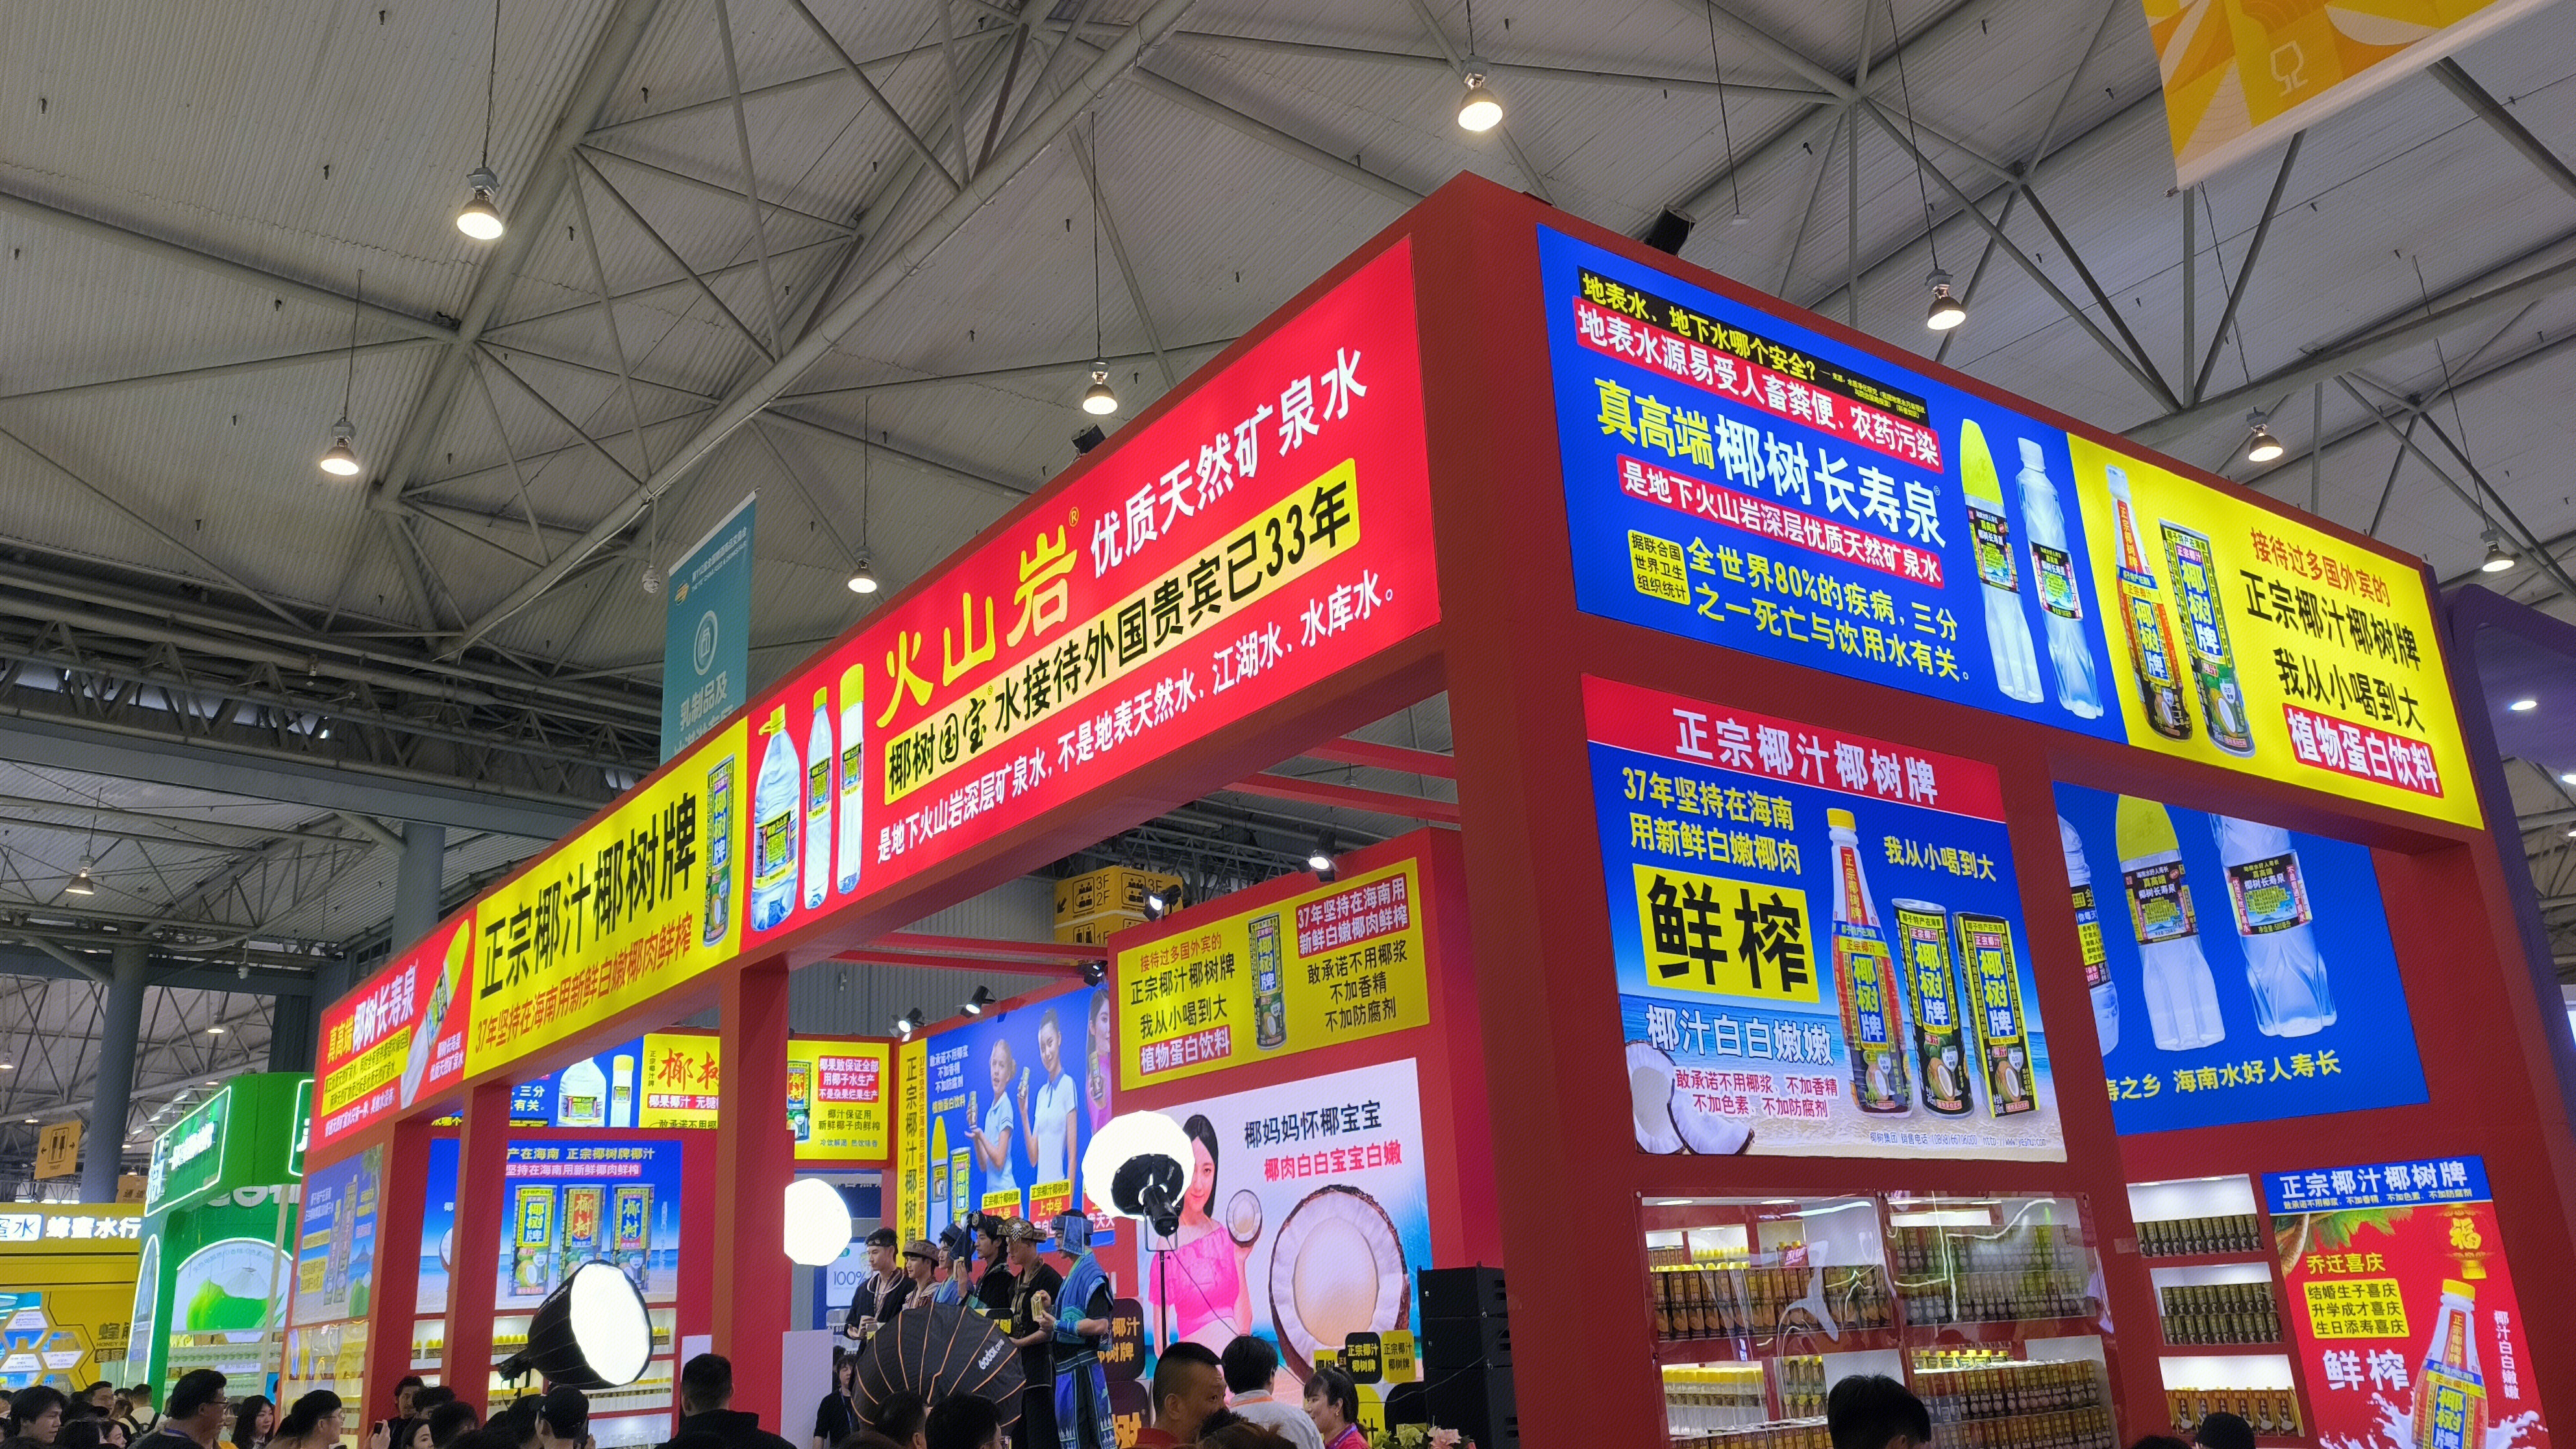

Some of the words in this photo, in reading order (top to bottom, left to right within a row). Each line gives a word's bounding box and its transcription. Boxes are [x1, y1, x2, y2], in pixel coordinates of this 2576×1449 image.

[1578, 304, 1940, 467] 地表水源易受人畜粪便、农药污染
[1089, 346, 1367, 580] 优质天然矿泉水
[1622, 461, 1942, 583] 是地下火山岩深层优质天然矿泉水
[1631, 533, 1681, 562] 据联合国
[1633, 554, 1685, 581] 世界卫生
[2250, 526, 2392, 608] 接待过多国外宾的
[1637, 574, 1687, 603] 组织统计
[2181, 559, 2220, 654] 椰树牌
[1696, 584, 1970, 683] 之一死亡与饮用水有关。
[2134, 599, 2170, 680] 椰树牌
[2239, 569, 2421, 671] 正宗椰汁椰树牌
[680, 670, 727, 732] 乳制品及
[2272, 647, 2425, 734] 我从小喝到大
[1672, 708, 1938, 805] 正宗椰汁椰树牌
[2288, 707, 2440, 795] 植物蛋白饮料
[1622, 767, 1796, 832] 37年坚持在海南
[1629, 812, 1802, 876] 用新鲜白嫩椰肉
[1883, 835, 1996, 882] 我从小喝到大
[480, 791, 696, 1000] 正宗椰汁椰树牌
[1096, 874, 1110, 890] 3F
[1096, 889, 1110, 907] 2F
[1147, 878, 1163, 893] 3F
[1298, 877, 1406, 930] 37年坚持在海南用
[1298, 904, 1409, 956] 新鲜白嫩椰肉鲜榨
[1647, 873, 1809, 993] 鲜榨
[1846, 939, 1876, 954] 正宗椰汁
[1910, 927, 1938, 941] 正宗椰汁
[1974, 934, 2001, 948] 正宗椰汁
[1140, 932, 1222, 972] 接待过多国外宾的
[1257, 935, 1276, 991] 椰树牌
[1307, 939, 1408, 986] 敢承诺不用椰浆
[475, 910, 693, 1054] 37年坚持在海南用新鲜白嫩椰肉鲜榨
[1130, 952, 1235, 1006] 正宗椰汁椰树牌
[1330, 972, 1387, 1006] 不加香精
[1852, 955, 1883, 1043] 椰树牌
[1914, 941, 1948, 1025] 椰树牌
[1979, 949, 2013, 1037] 椰树牌
[1140, 995, 1228, 1040] 我从小喝到大
[1324, 997, 1396, 1034] 不加防腐剂
[1644, 1004, 1835, 1067] 椰汁白白嫩嫩
[819, 1058, 879, 1073] 椰果敢保证全部
[929, 1045, 969, 1067] 敢承诺不用椰浆
[1141, 1026, 1230, 1074] 植物蛋白饮料
[2173, 1049, 2342, 1093] 海南水好人寿长
[823, 1072, 876, 1087] 用椰子水生产
[649, 1095, 691, 1108] 椰果椰汁
[828, 1109, 872, 1121] 椰汁保证用
[818, 1120, 880, 1131] 新鲜椰子肉鲜榨
[1244, 1100, 1383, 1149] 椰妈妈怀椰宝宝
[566, 1147, 656, 1161] 正宗椰树牌椰汁
[1263, 1139, 1402, 1182] 椰肉白白宝宝白嫩
[983, 1191, 1019, 1207] 正宗椰汁椰树牌
[1031, 1181, 1069, 1199] 正宗椰汁椰树牌
[2279, 1161, 2468, 1199] 正宗椰汁椰树牌
[526, 1202, 545, 1243] 椰树牌
[573, 1195, 593, 1237] 椰树
[622, 1198, 641, 1239] 椰树
[1038, 1198, 1063, 1217] 上中学
[2306, 1253, 2386, 1275] 乔迁喜庆
[2308, 1282, 2397, 1300] 结婚生子喜庆
[2311, 1300, 2401, 1318] 升学成才喜庆
[1111, 1316, 1141, 1338] 椰汁
[2315, 1319, 2406, 1336] 生日添寿喜庆
[1347, 1343, 1380, 1357] 正宗椰汁
[1351, 1359, 1376, 1372] 椰树牌
[1383, 1341, 1413, 1356] 正宗椰汁
[1387, 1357, 1411, 1372] 椰树牌
[2494, 1309, 2521, 1400] 椰汁白白嫩嫩
[2322, 1349, 2410, 1391] 鲜榨
